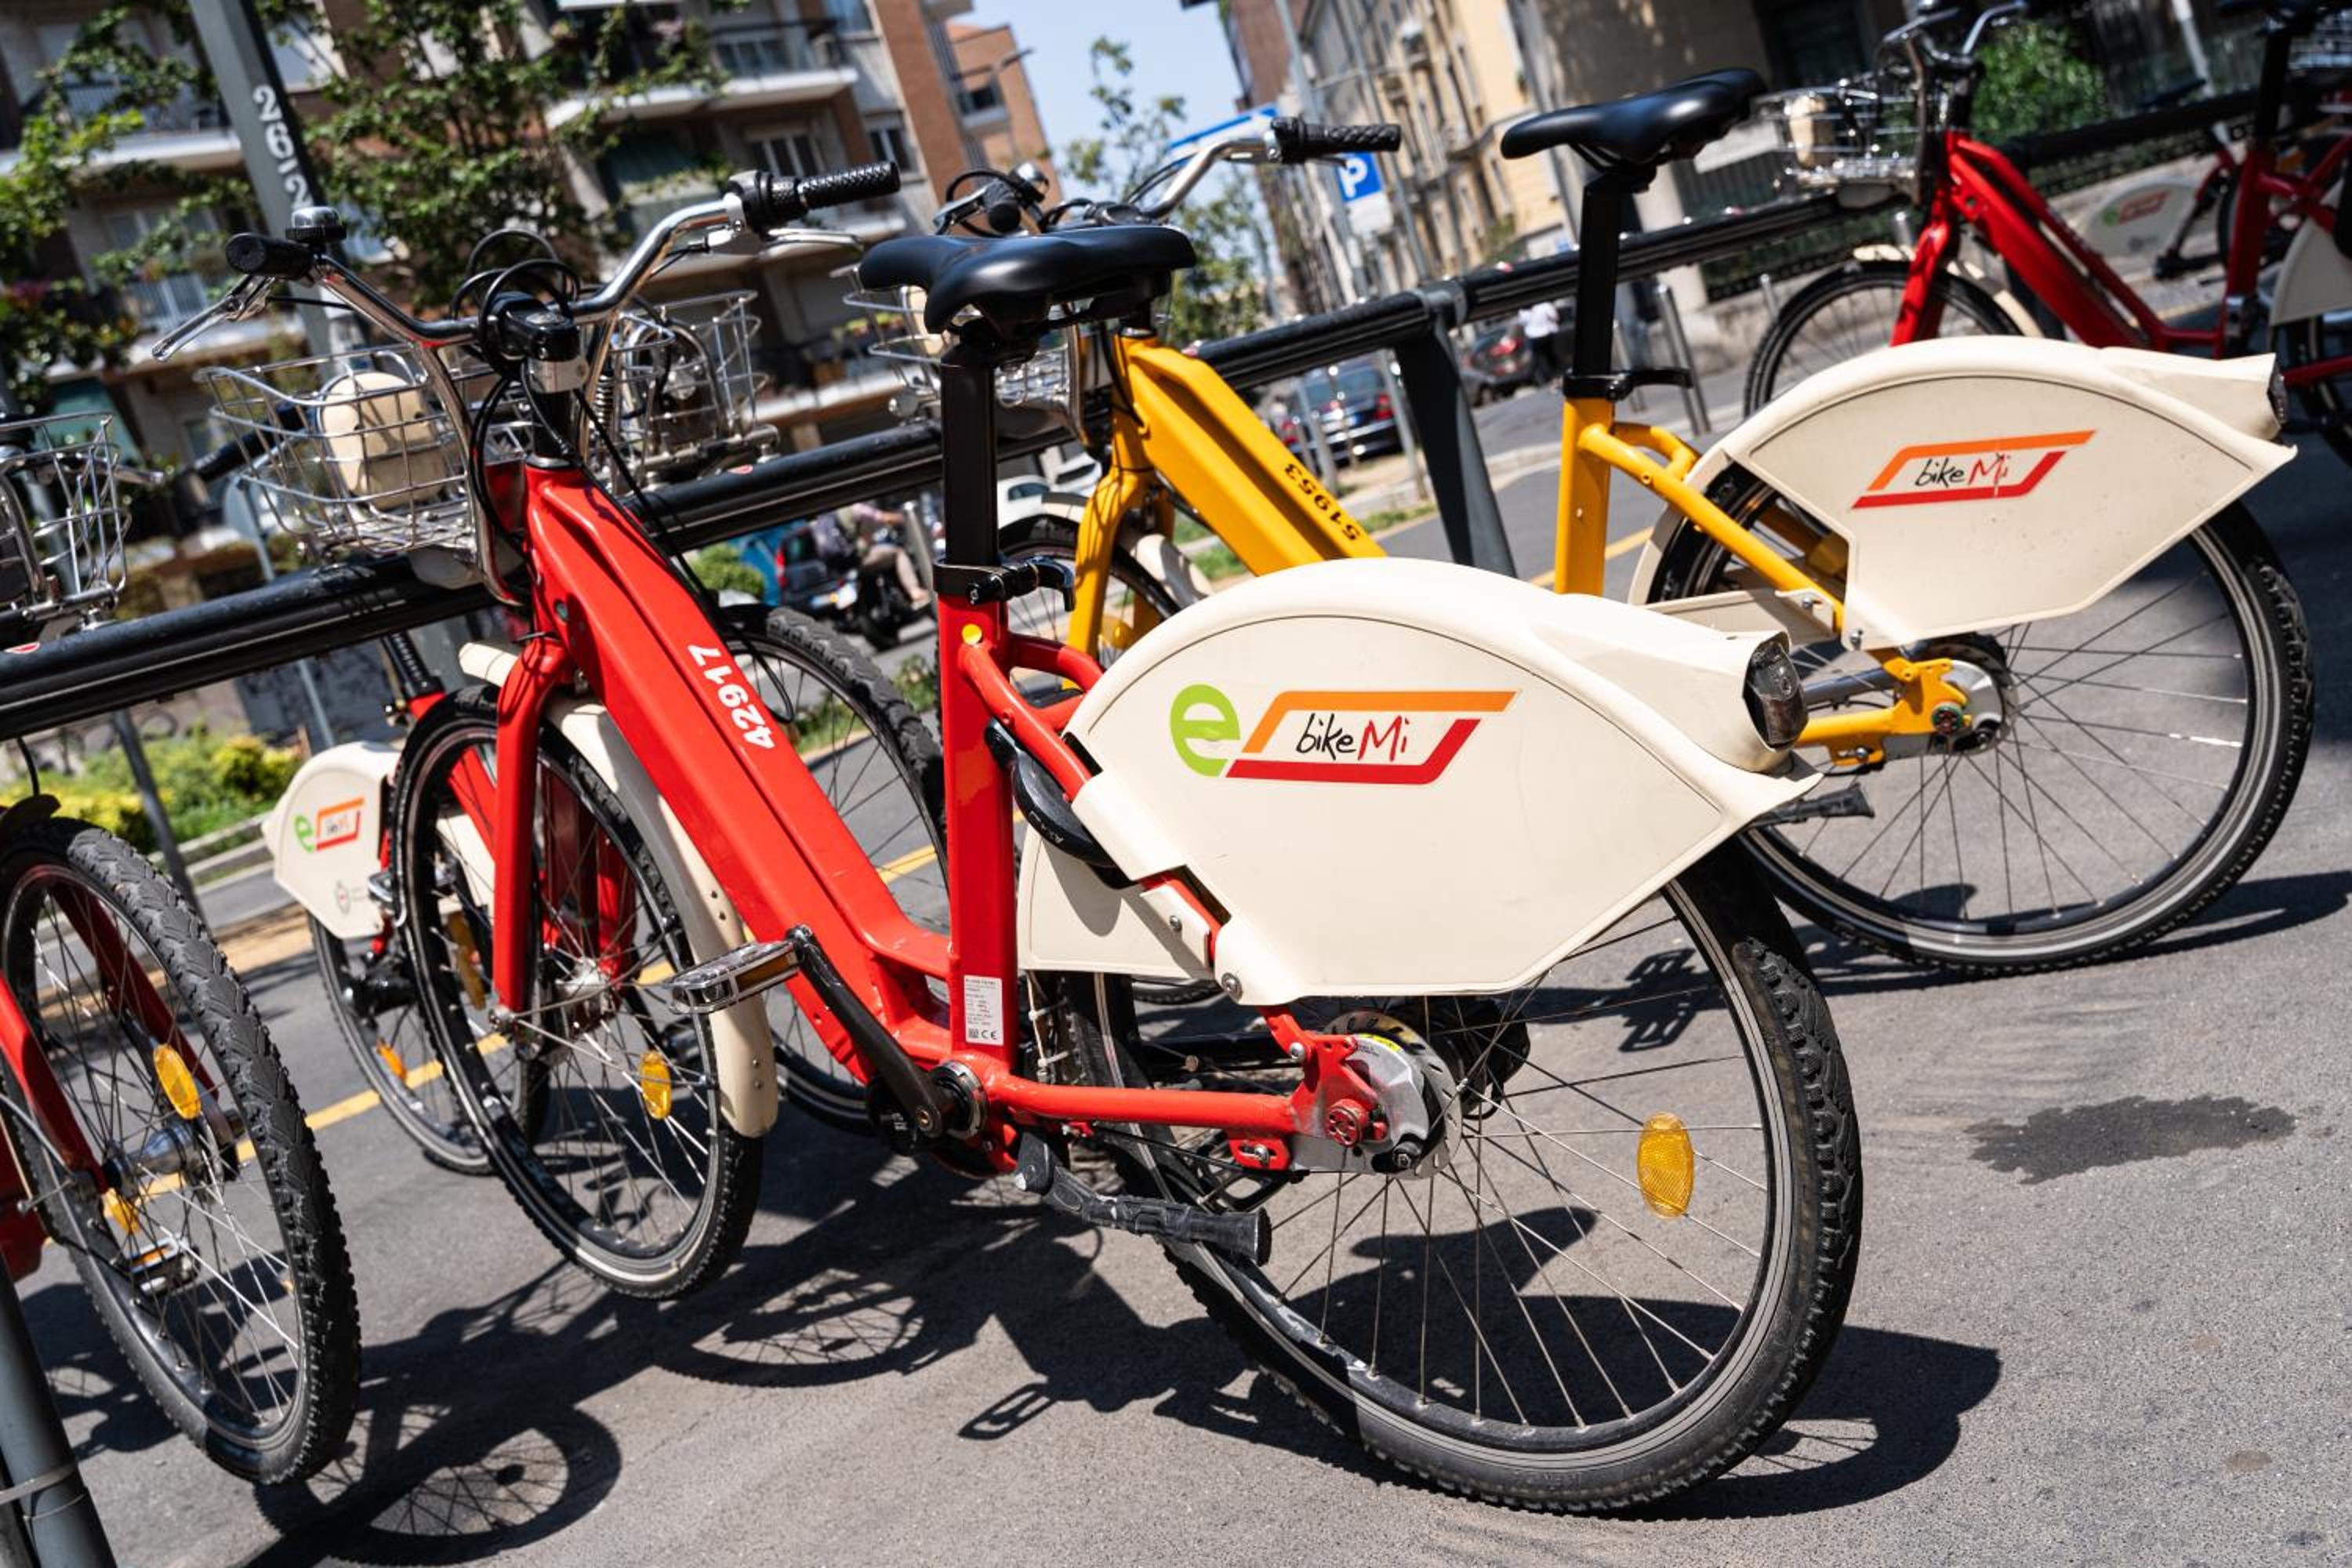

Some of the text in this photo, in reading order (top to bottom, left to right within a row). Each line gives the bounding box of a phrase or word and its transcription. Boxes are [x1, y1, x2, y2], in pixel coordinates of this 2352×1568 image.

[253, 85, 314, 209] 2612
[1338, 157, 1367, 198] P
[1284, 463, 1361, 541] 51953
[687, 644, 775, 749] 42917
[1295, 713, 1410, 762] bikeMi
